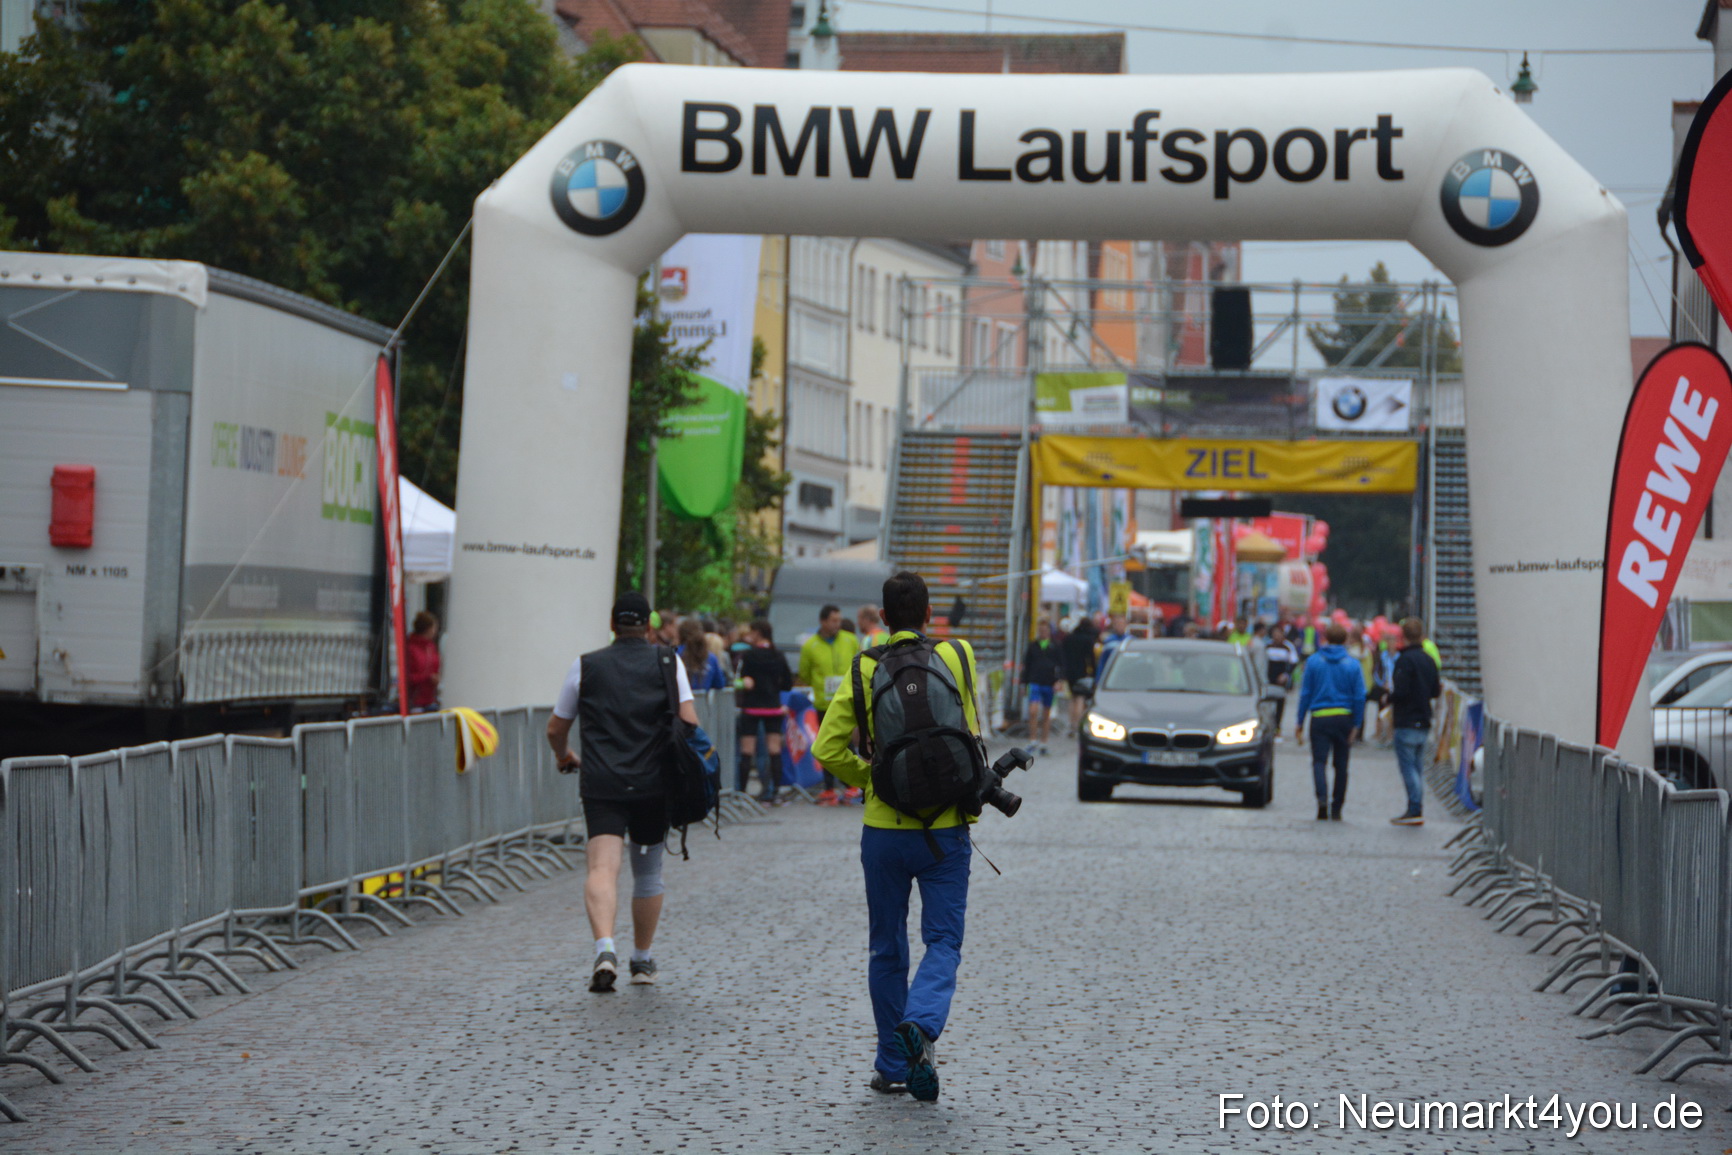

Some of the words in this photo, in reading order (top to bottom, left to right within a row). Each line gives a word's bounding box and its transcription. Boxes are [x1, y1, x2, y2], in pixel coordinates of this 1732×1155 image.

[558, 141, 638, 177] BMW
[680, 101, 931, 180] BMW
[958, 109, 1404, 199] Laufsport
[1450, 149, 1535, 186] BMW
[1185, 449, 1268, 479] ZIEL
[1617, 375, 1720, 609] REWE
[462, 540, 597, 560] www.bmw-laufsport.de
[1489, 556, 1605, 574] www.bmw-laufspo
[66, 564, 87, 577] NM
